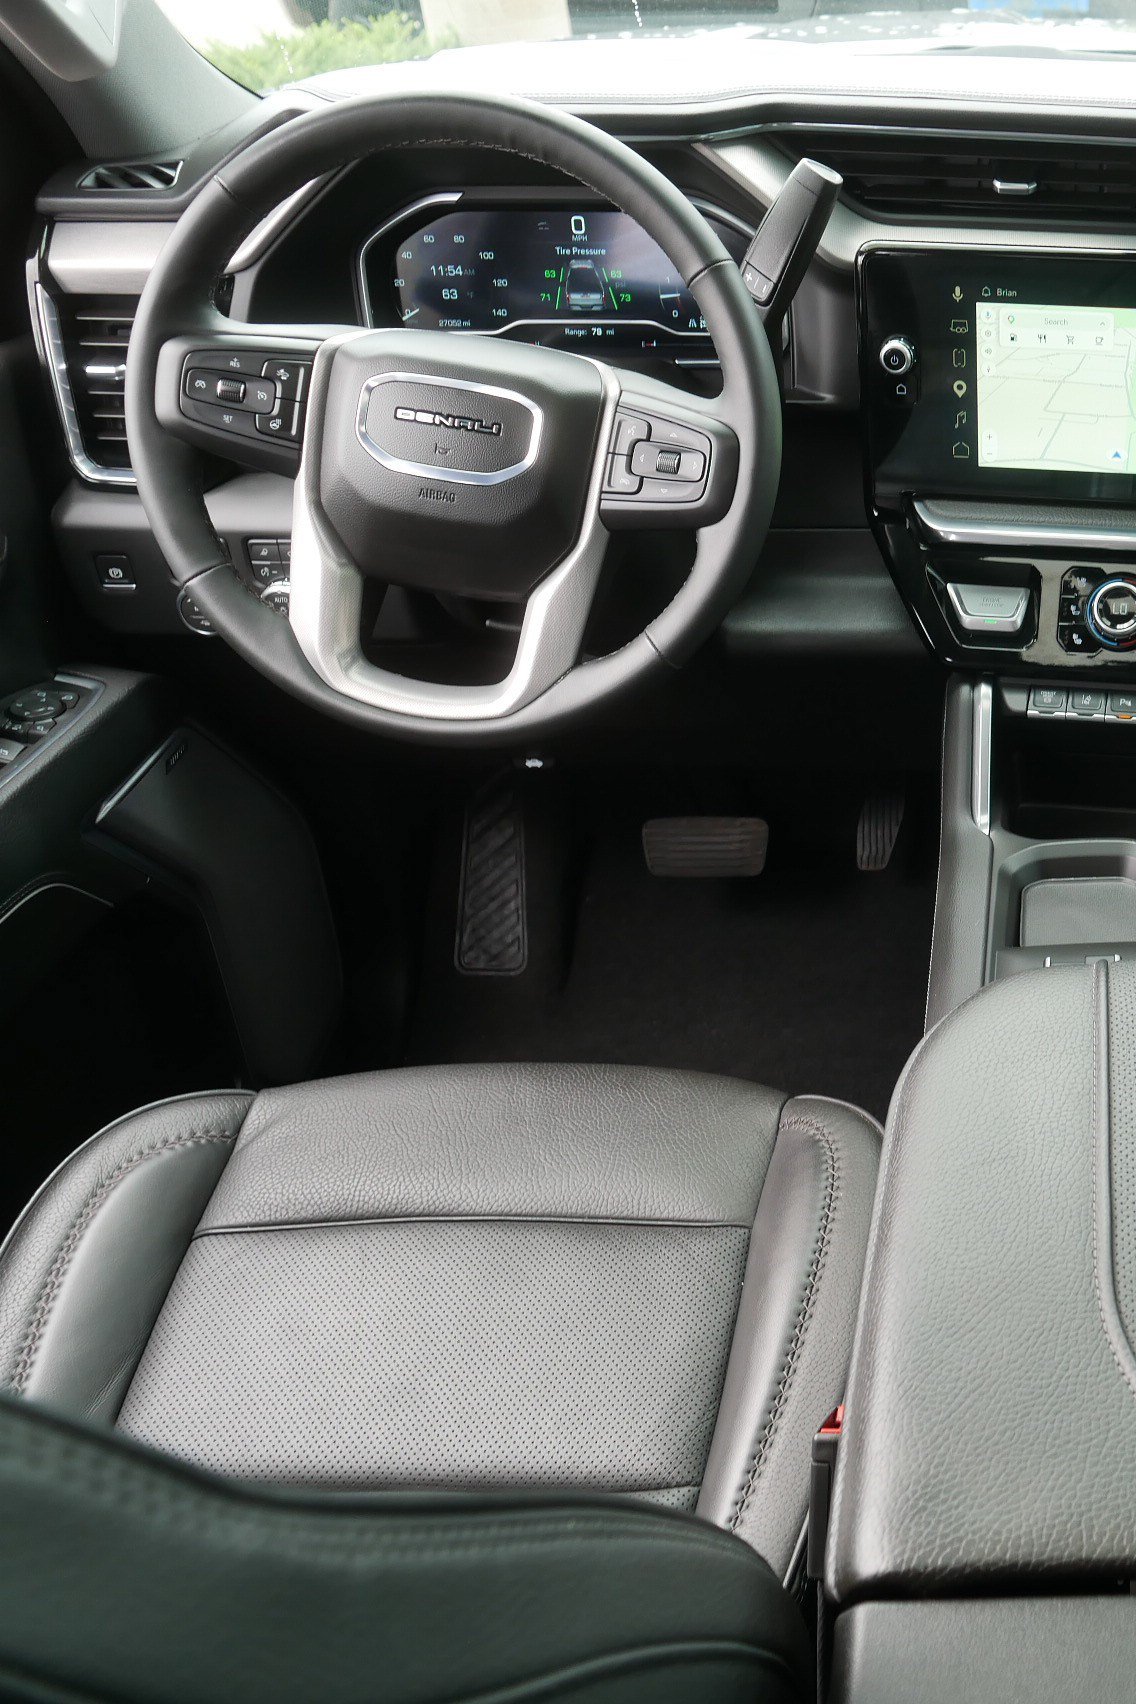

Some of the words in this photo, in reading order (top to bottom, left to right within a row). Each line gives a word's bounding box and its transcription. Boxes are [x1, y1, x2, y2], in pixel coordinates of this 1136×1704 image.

[424, 235, 435, 243] 60
[454, 235, 465, 243] 80
[555, 247, 571, 255] Tire
[572, 247, 606, 255] Pressure
[479, 252, 494, 260] 100
[430, 265, 463, 276] 11:54
[394, 279, 405, 287] 20
[493, 279, 508, 287] 120
[442, 289, 458, 299] 63
[996, 288, 1017, 297] Brian
[540, 293, 551, 301] 71
[620, 294, 632, 302] 73
[1044, 317, 1069, 327] Search
[564, 328, 588, 337] Range:
[394, 406, 503, 436] DENALI
[419, 488, 456, 503] AIRBAG
